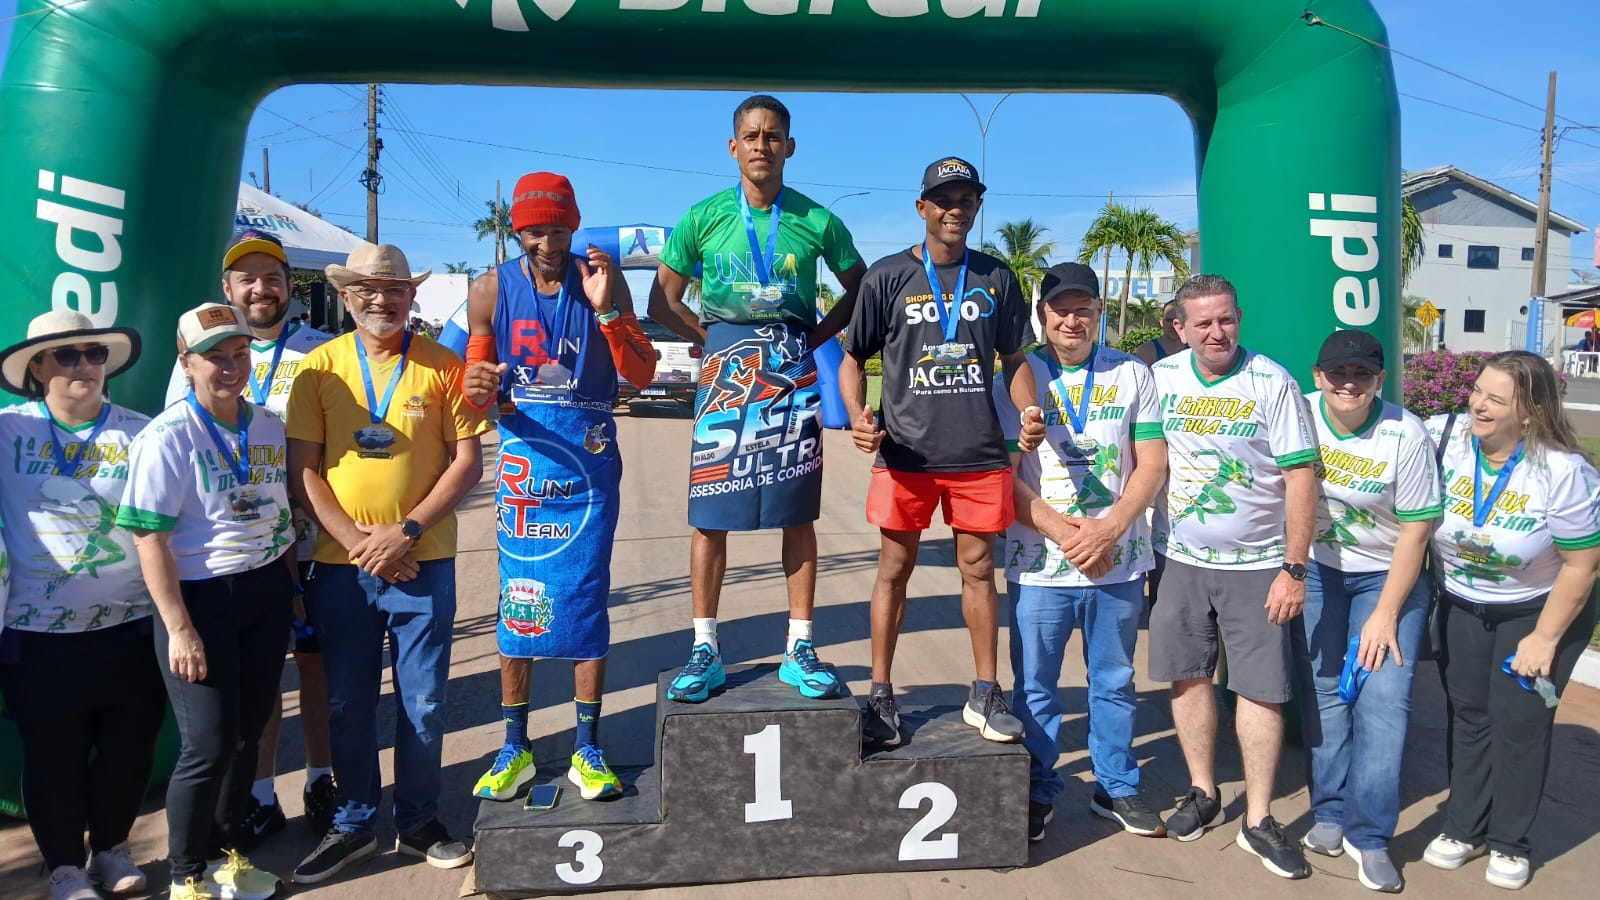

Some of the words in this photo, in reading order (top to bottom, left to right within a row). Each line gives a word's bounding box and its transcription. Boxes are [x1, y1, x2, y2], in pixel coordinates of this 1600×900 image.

[36, 169, 126, 330] edi
[1308, 192, 1381, 331] edi
[1098, 276, 1158, 298] OEL
[908, 364, 985, 389] JACIAR
[745, 440, 770, 451] ESTELA
[495, 453, 573, 499] RUN
[757, 471, 774, 487] DE
[777, 455, 823, 482] CORRID
[503, 496, 570, 539] TEAM
[743, 724, 793, 823] 1
[897, 782, 959, 861] 2
[555, 830, 603, 884] 3
